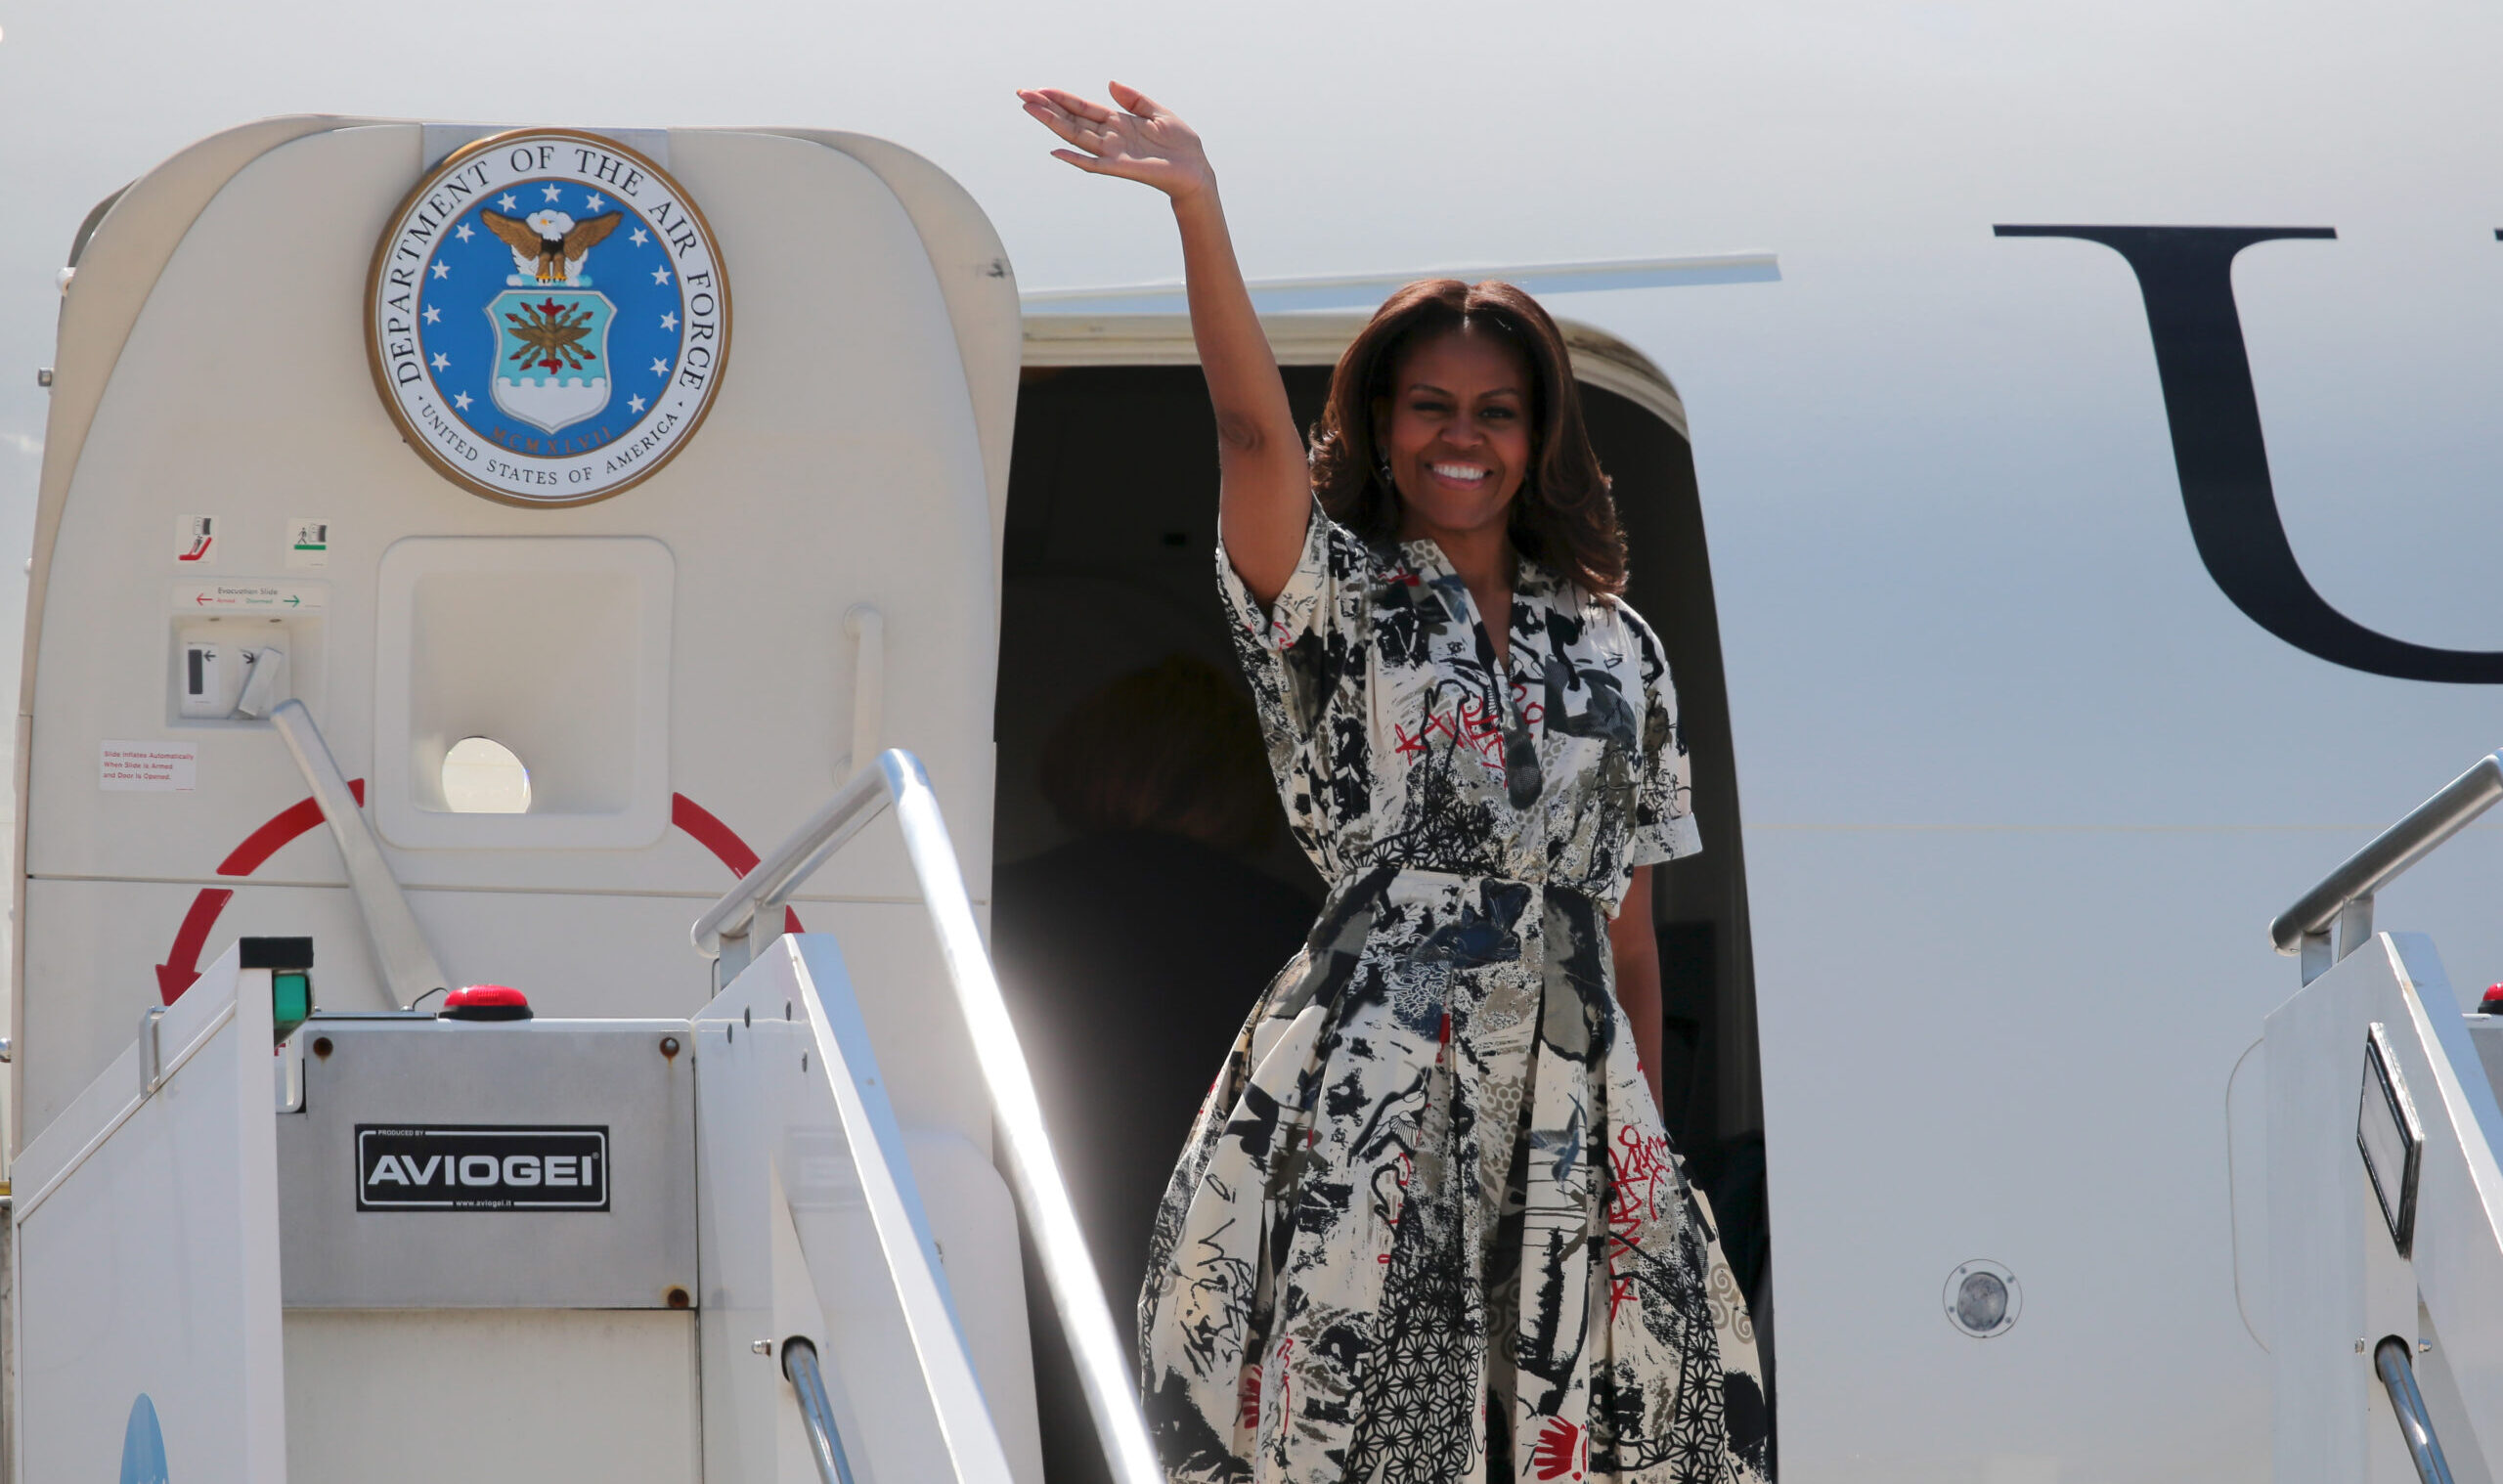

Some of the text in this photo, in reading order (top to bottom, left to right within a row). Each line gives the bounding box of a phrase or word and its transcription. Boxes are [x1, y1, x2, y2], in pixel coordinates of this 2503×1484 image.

[388, 146, 715, 391] DEPARTMENT OF THE AIR FORCE
[420, 403, 679, 485] UNITED STATES OF AMERICA
[488, 425, 613, 456] MCMXLVII
[149, 752, 195, 761] Automatically
[456, 1200, 512, 1208] www.aviogei.it
